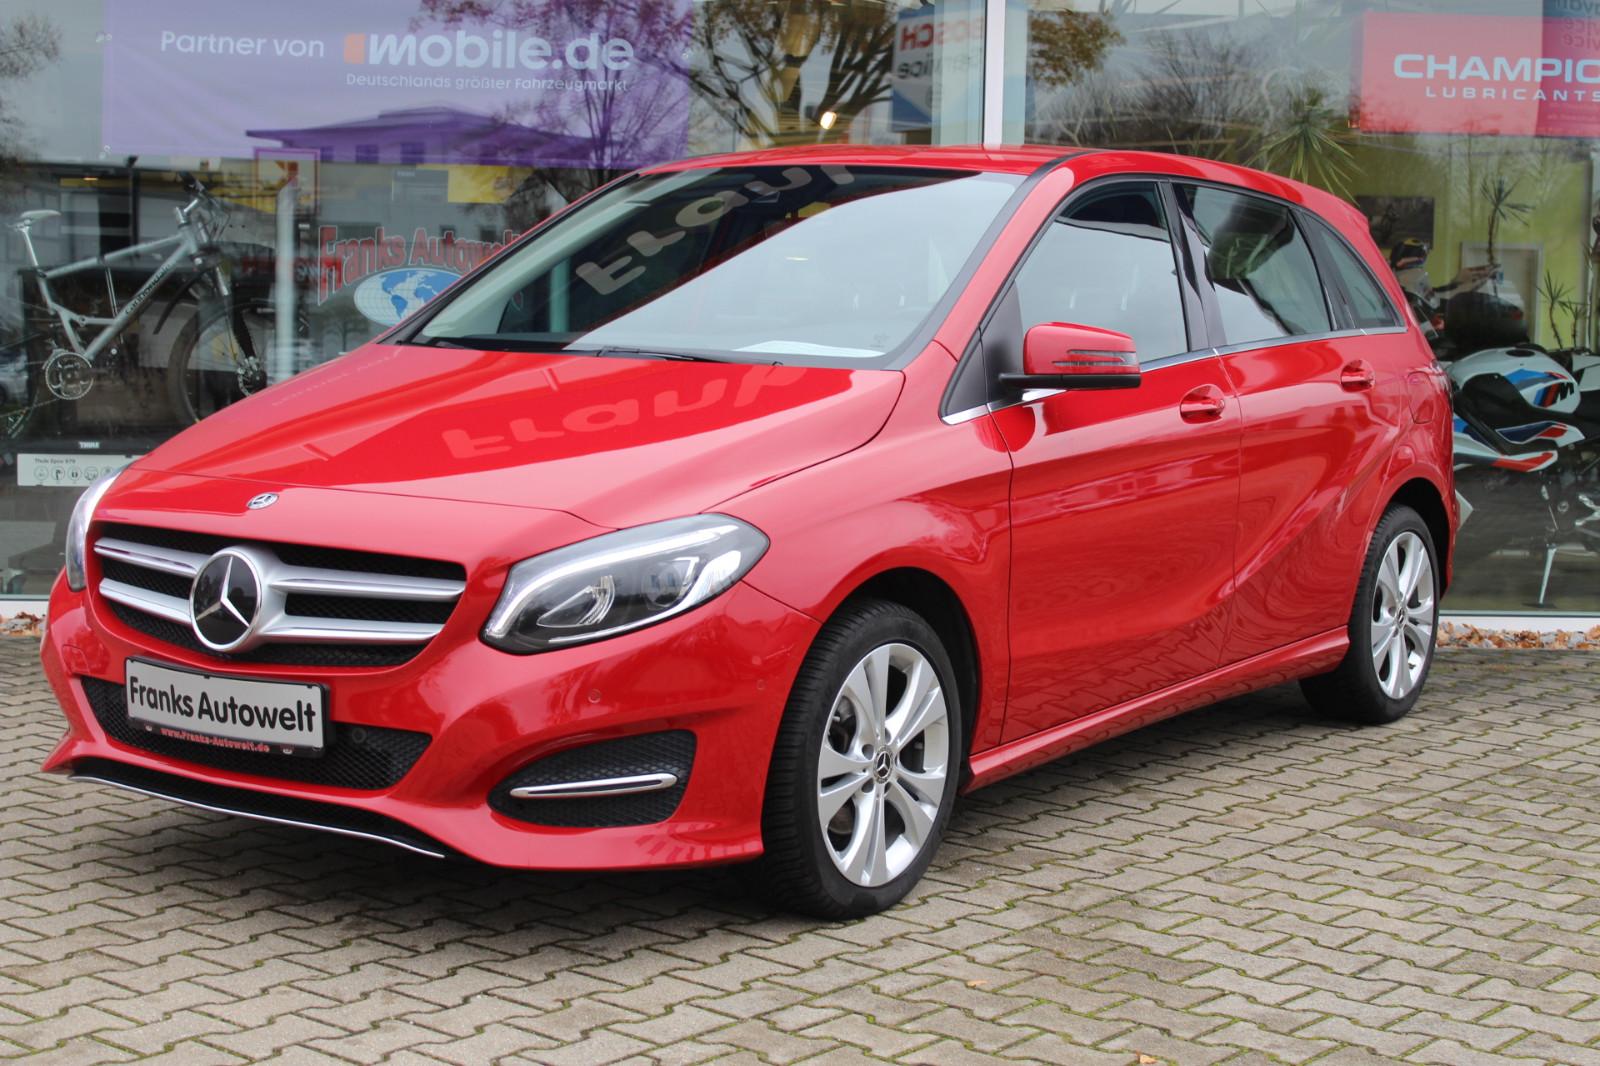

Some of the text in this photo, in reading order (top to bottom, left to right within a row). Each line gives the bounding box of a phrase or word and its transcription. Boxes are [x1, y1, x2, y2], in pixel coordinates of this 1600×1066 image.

[160, 30, 324, 57] Partner von
[368, 29, 634, 71] mobile.de
[346, 73, 628, 92] Deutschlands größter Fahrzeugmarkt
[318, 225, 521, 306] Franks Autow
[130, 676, 316, 733] Franks Autowelt
